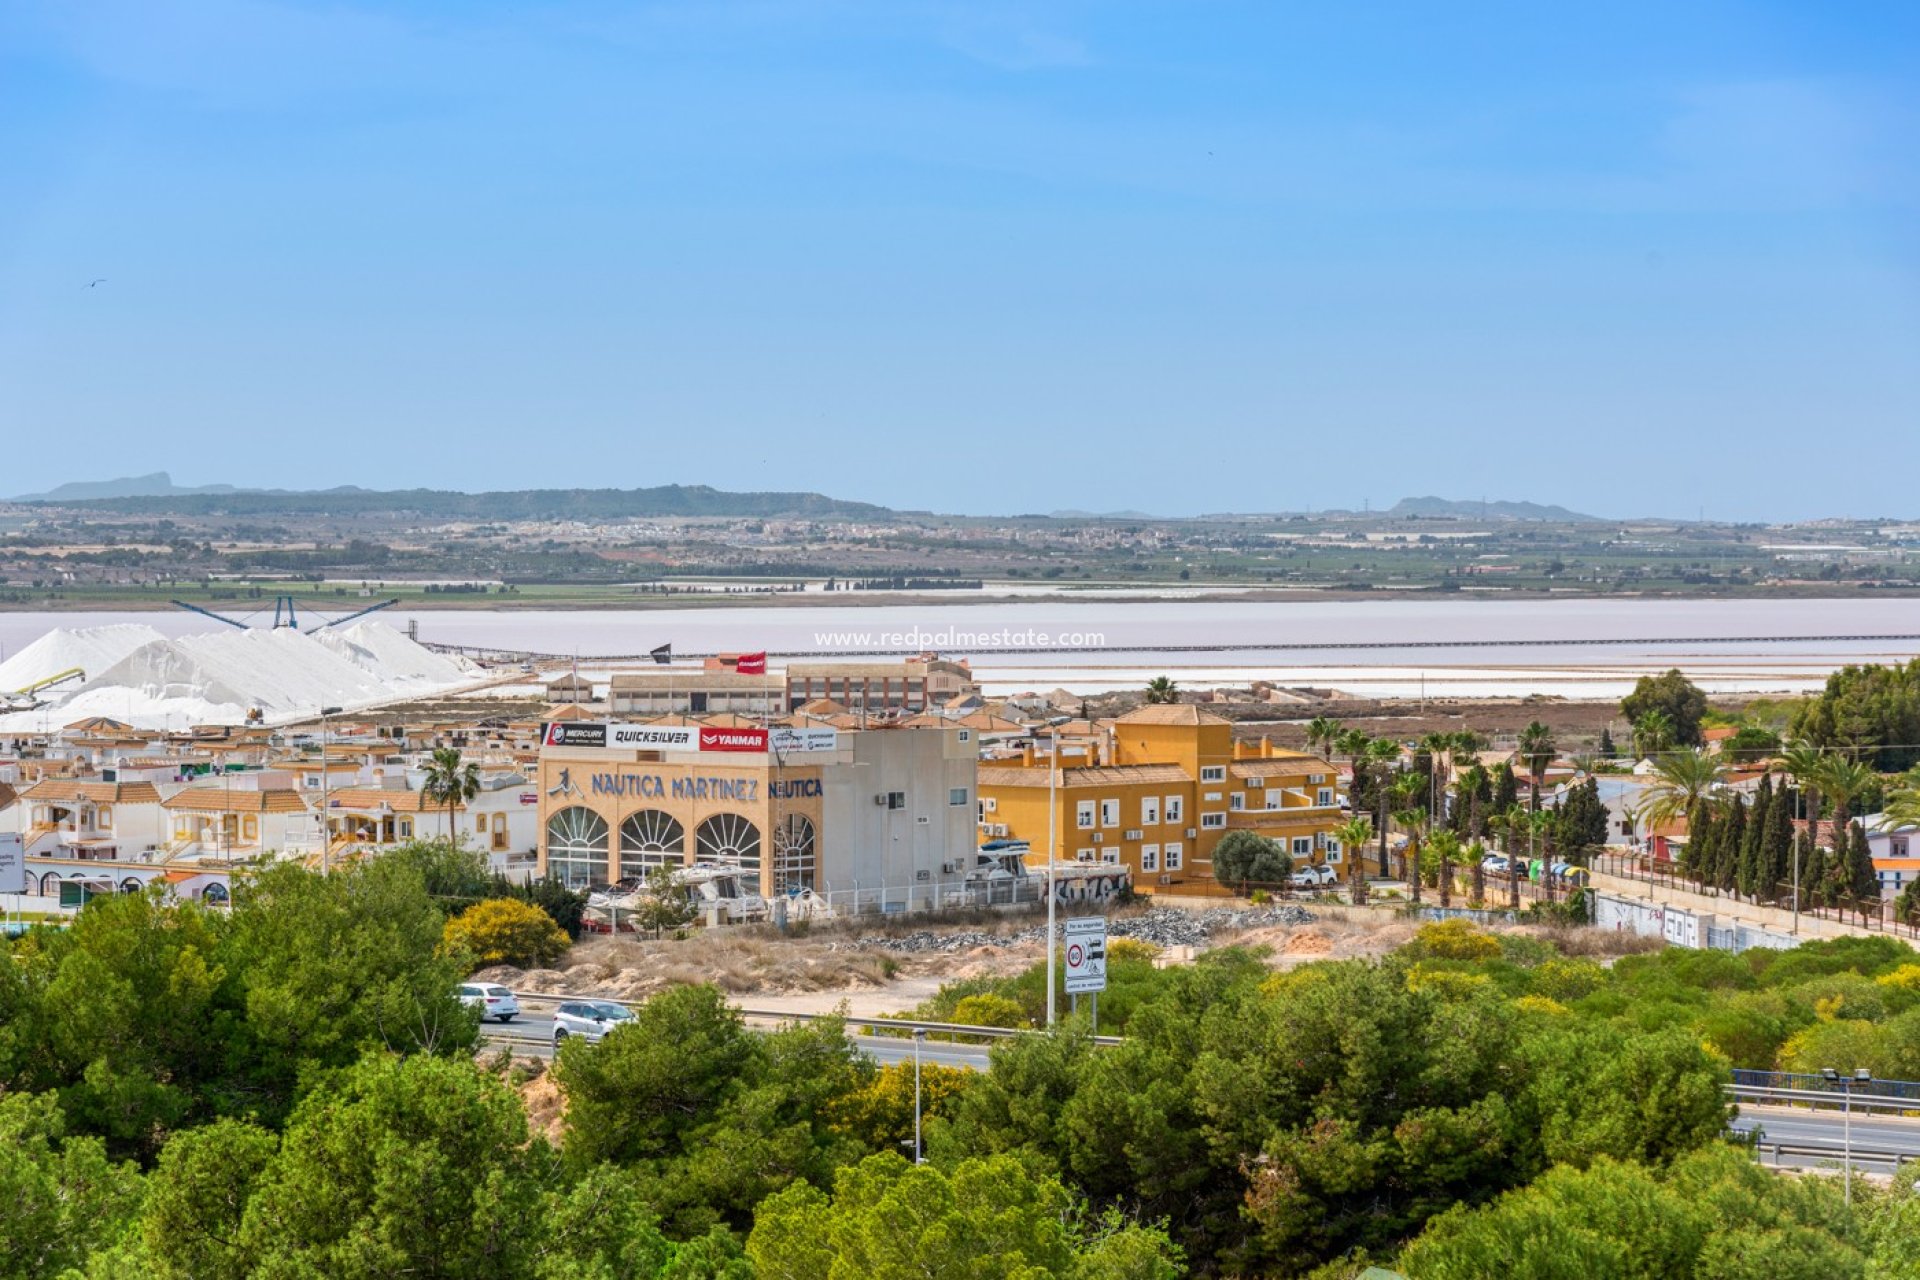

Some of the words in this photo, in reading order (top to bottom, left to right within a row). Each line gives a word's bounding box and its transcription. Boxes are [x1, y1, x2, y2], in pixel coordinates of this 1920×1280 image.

[566, 729, 604, 738] MERCURY
[615, 730, 690, 744] QUICKSILVER
[718, 734, 762, 746] YANMAR
[592, 773, 665, 798] NAUTICA
[672, 776, 758, 801] MARTINEZ
